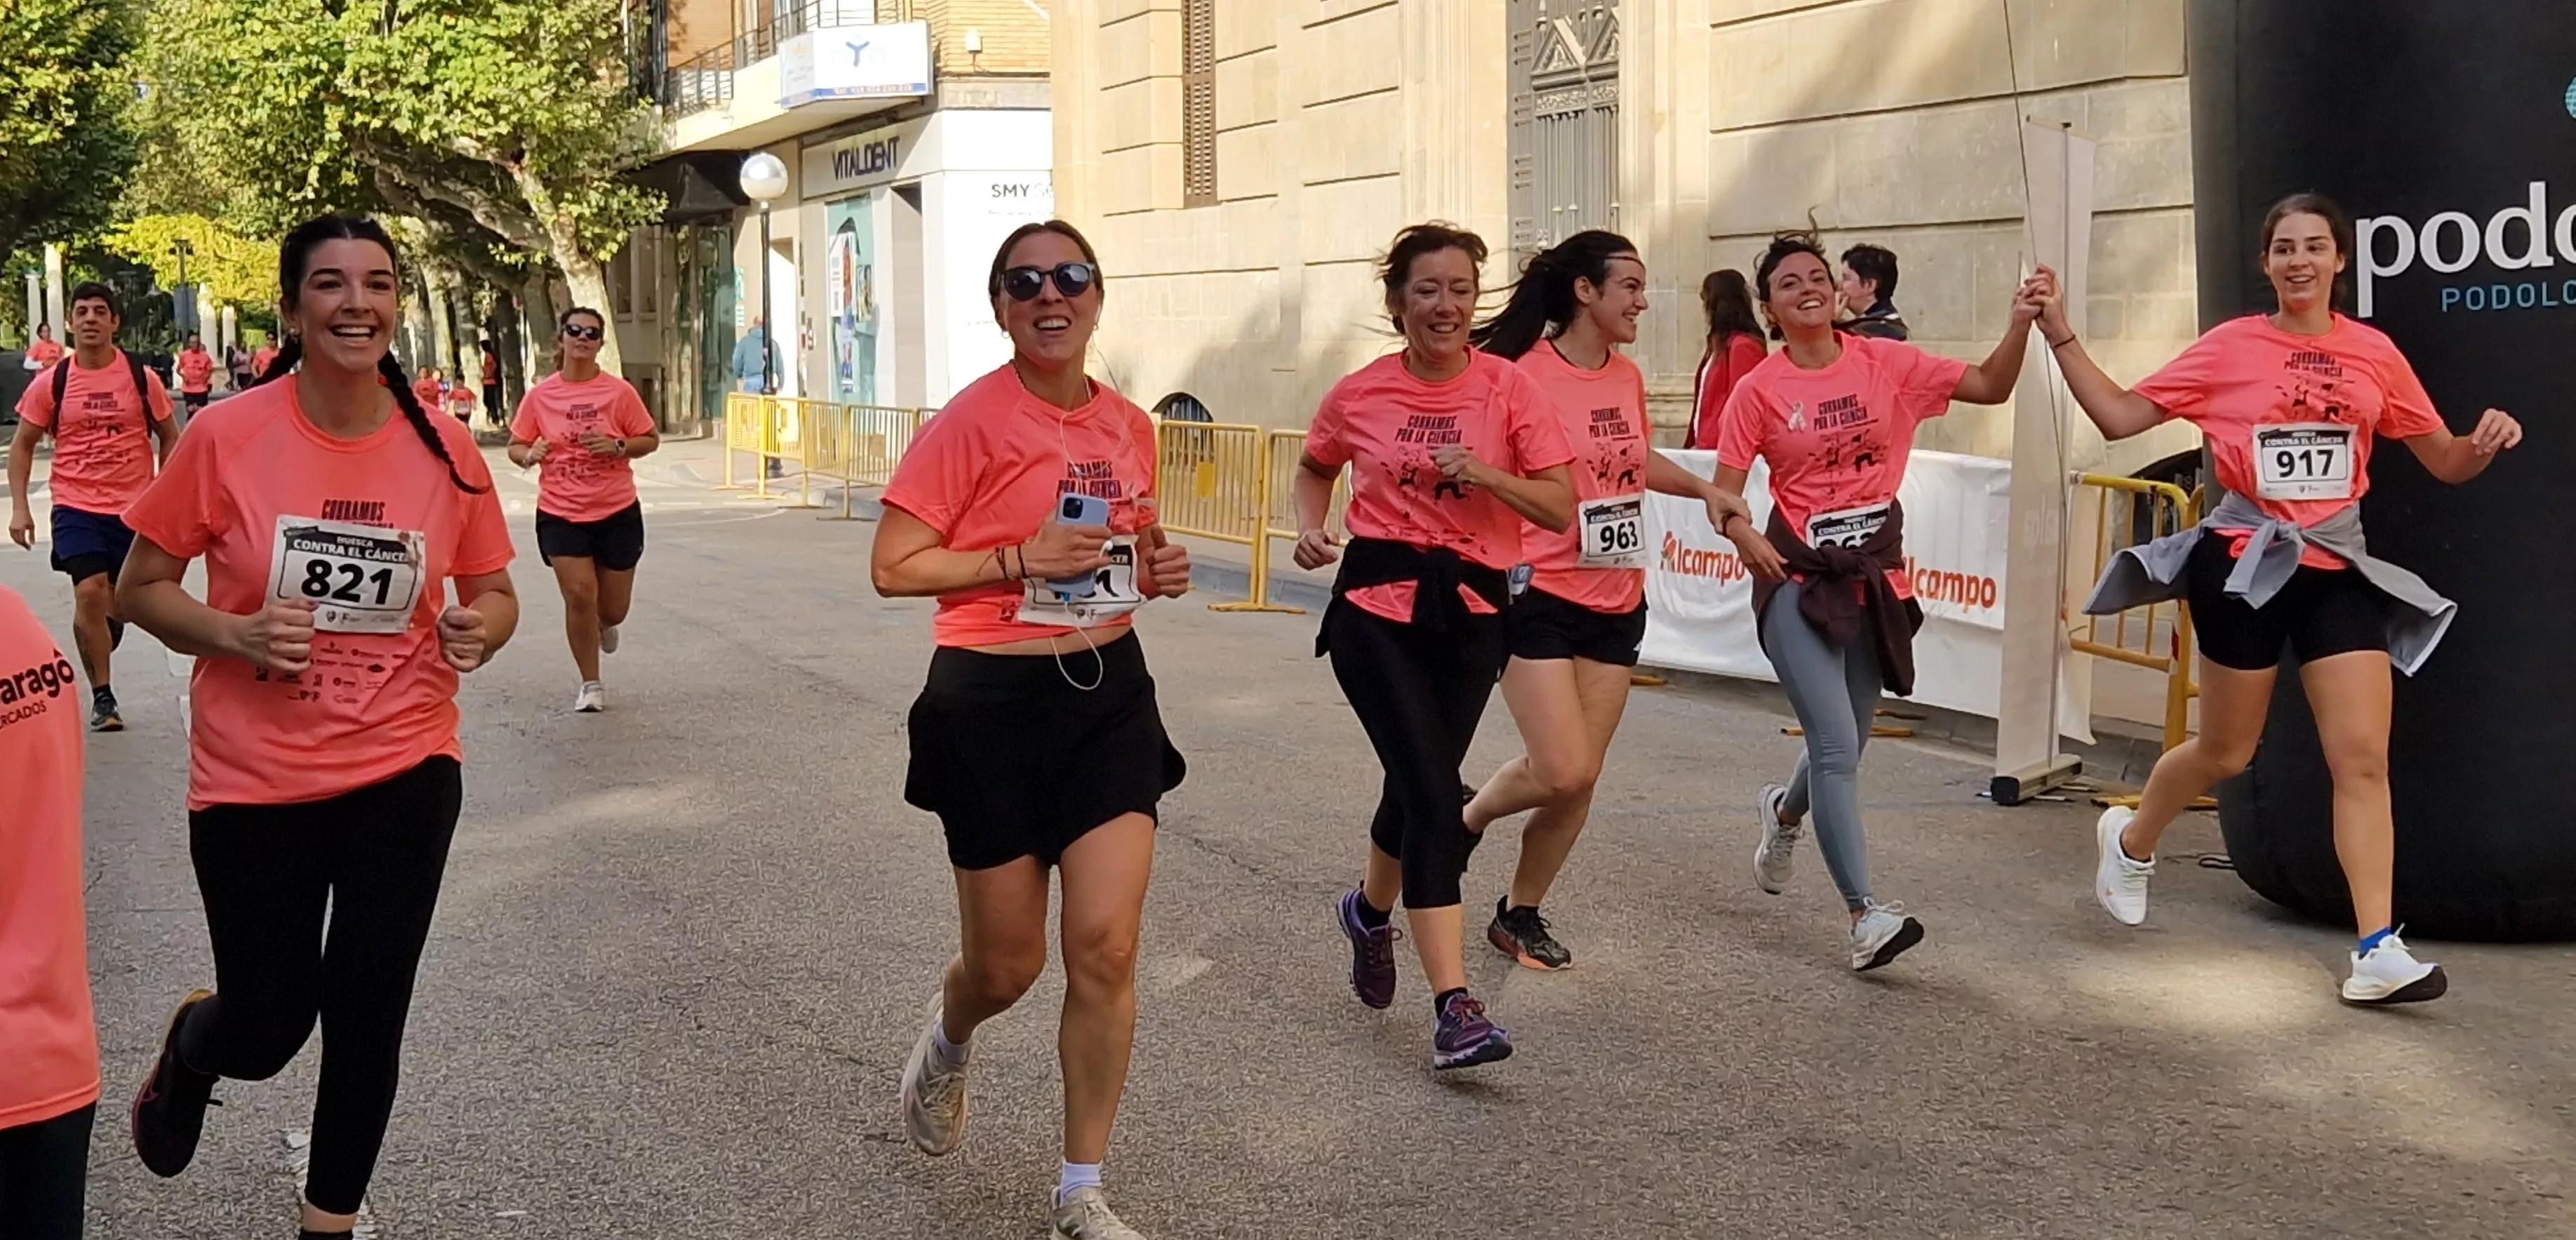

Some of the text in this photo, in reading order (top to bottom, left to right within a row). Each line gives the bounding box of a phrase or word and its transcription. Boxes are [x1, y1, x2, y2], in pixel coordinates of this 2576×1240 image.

[831, 135, 900, 180] VITALDENT
[992, 183, 1030, 198] SMY
[1394, 427, 1414, 442] POR
[2276, 449, 2335, 478] 917
[321, 499, 387, 521] CORRAMOS
[293, 538, 345, 556] CONTRA
[348, 547, 362, 559] EL
[1600, 521, 1639, 552] 963
[300, 558, 393, 606] 821
[1904, 555, 1996, 614] lcampo
